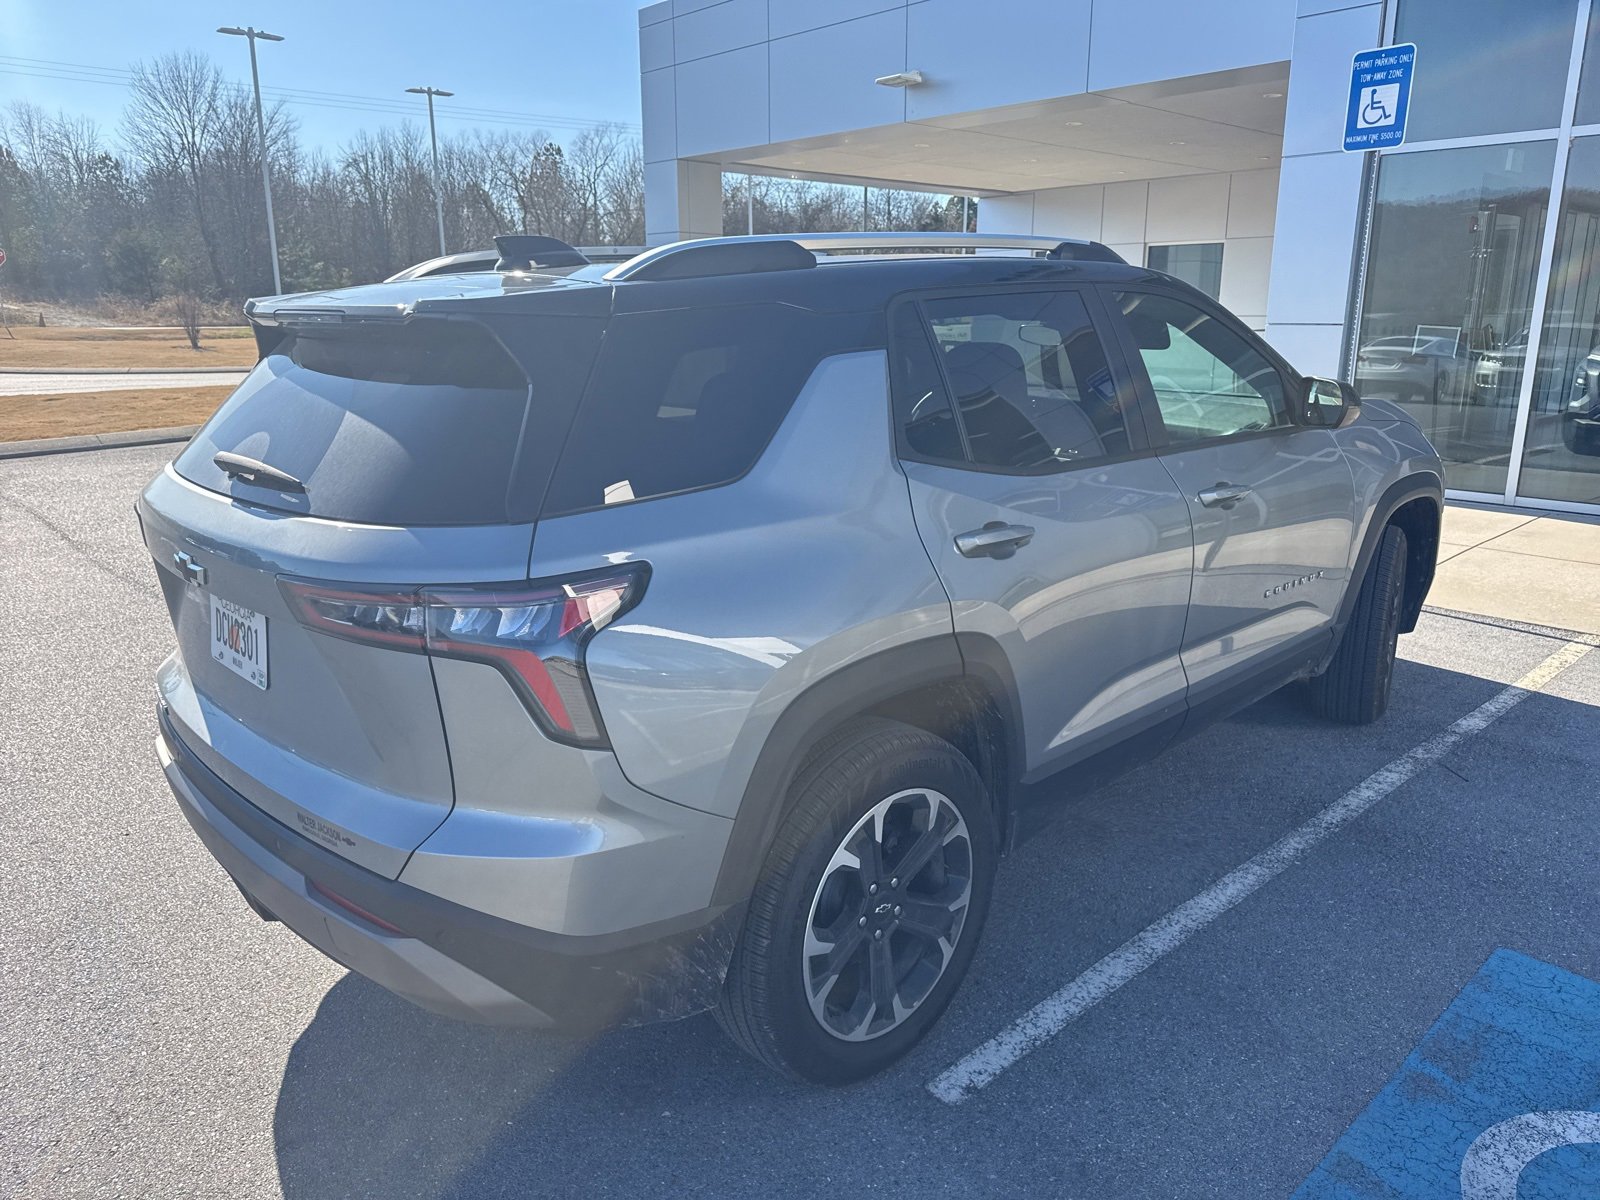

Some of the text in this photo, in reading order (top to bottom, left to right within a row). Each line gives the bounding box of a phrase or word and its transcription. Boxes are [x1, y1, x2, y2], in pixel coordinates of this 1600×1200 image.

[1354, 53, 1414, 71] PERMIT PARKING ONLY
[1388, 68, 1404, 79] ZONE
[1345, 135, 1368, 144] MAXIMUM
[1368, 133, 1379, 142] FINE
[1263, 569, 1324, 598] EQUINOX
[215, 606, 259, 666] DCU2301
[317, 821, 342, 842] JACKSON
